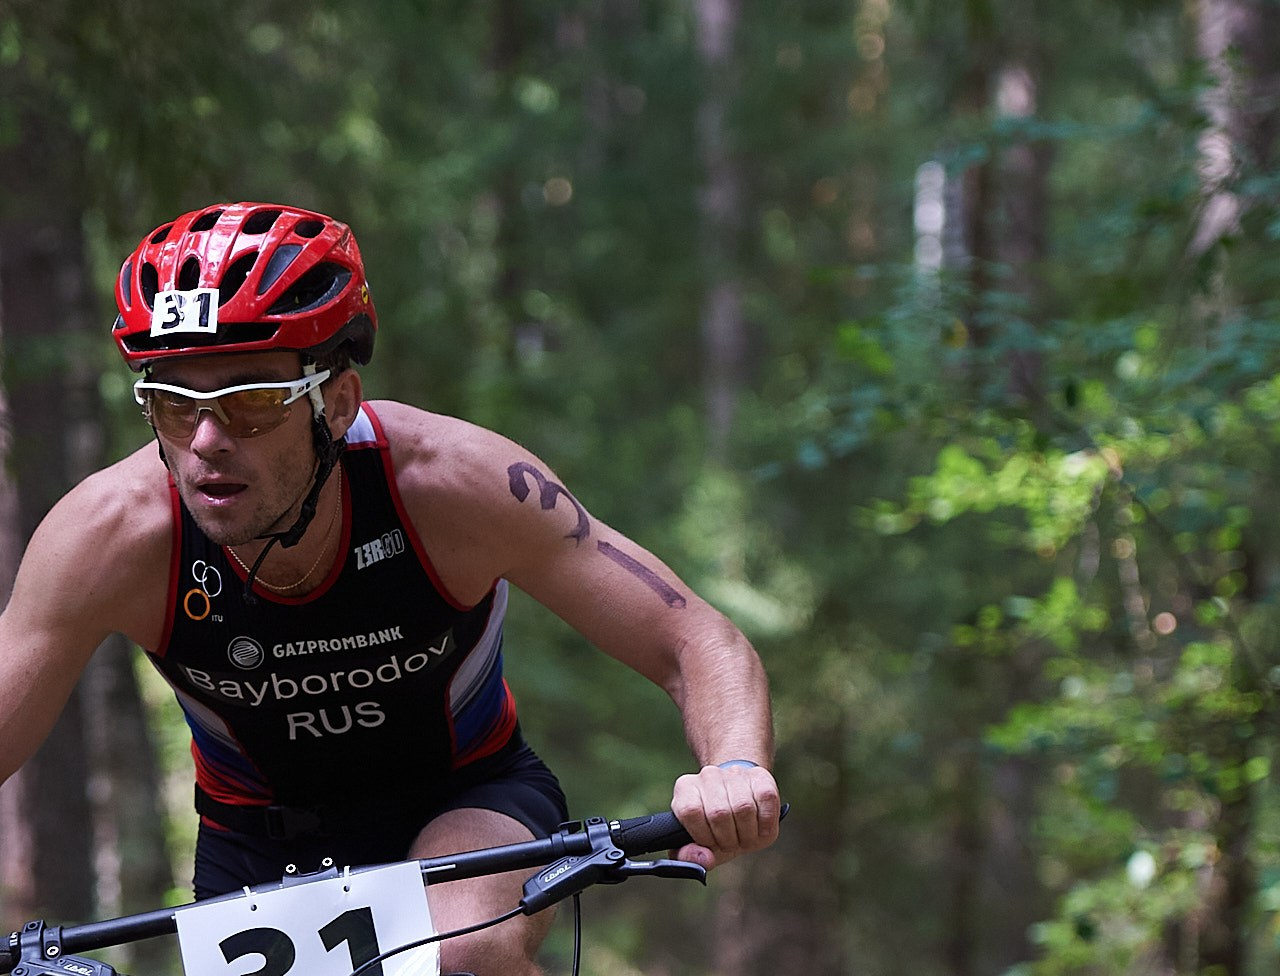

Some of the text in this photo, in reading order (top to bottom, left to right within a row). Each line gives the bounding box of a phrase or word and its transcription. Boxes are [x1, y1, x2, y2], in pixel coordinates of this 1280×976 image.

[272, 625, 404, 658] GAZPROMBANK
[185, 635, 449, 707] Bayborodov
[286, 701, 386, 740] RUS
